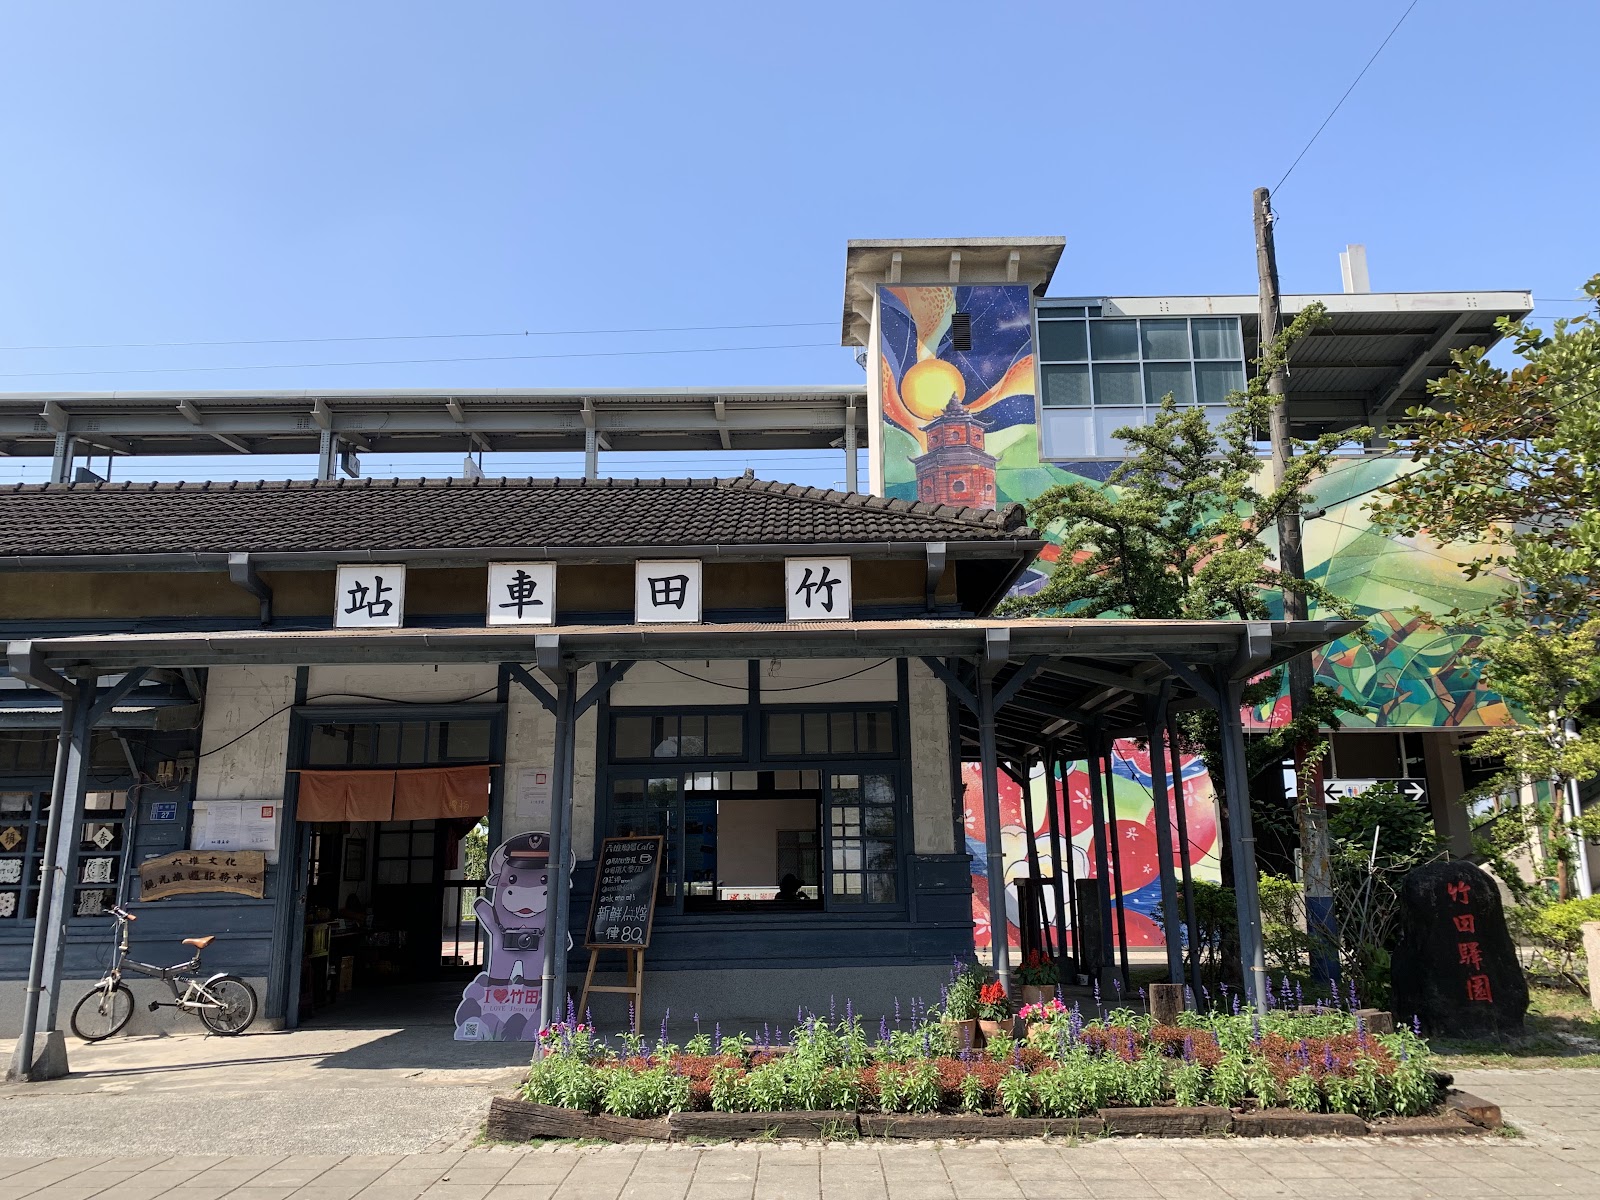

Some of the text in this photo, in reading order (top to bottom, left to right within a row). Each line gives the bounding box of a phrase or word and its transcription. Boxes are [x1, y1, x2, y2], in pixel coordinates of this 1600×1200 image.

[344, 566, 842, 619] 竹 田 車 站
[597, 904, 648, 922] 新鮮烘焙
[484, 989, 492, 1004] I
